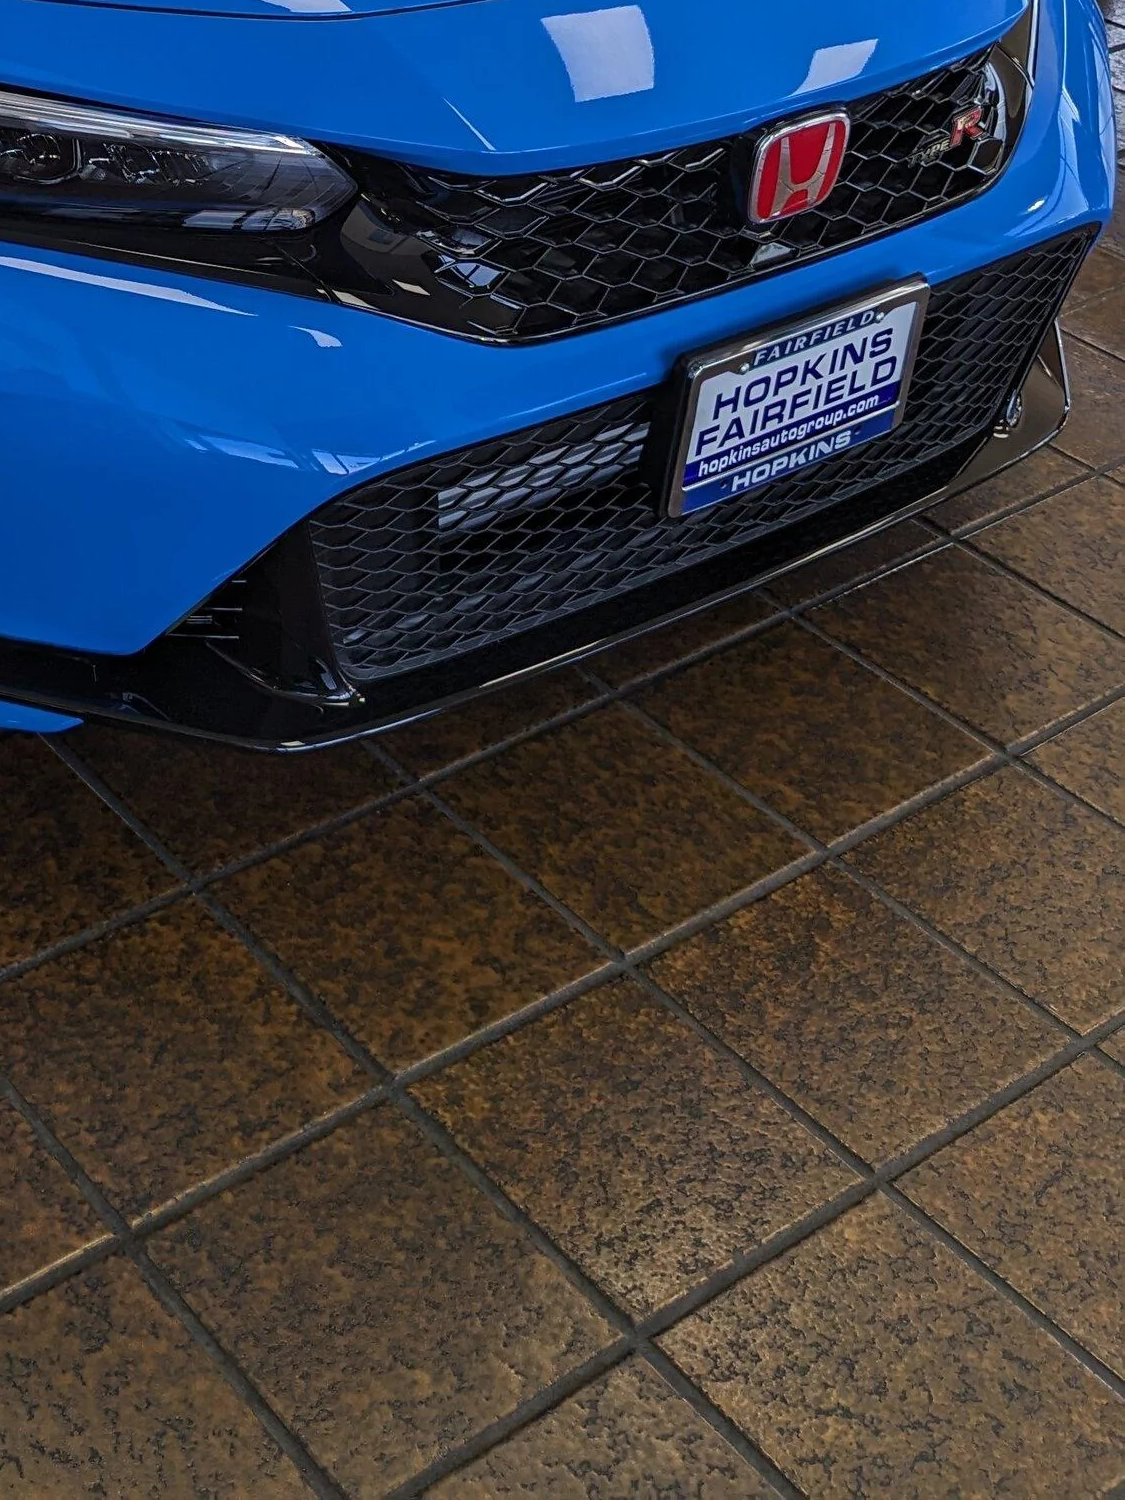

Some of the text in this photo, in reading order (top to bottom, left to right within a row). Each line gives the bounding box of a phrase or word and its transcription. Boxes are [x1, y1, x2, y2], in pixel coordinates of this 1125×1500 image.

[907, 105, 984, 169] TYPE R
[712, 326, 894, 421] HOPKINS
[753, 310, 876, 366] FAIRFIELD
[694, 355, 897, 457] FAIRFIELD
[697, 393, 880, 478] hopkinsautogroup.com
[731, 429, 852, 493] HOPKINS
